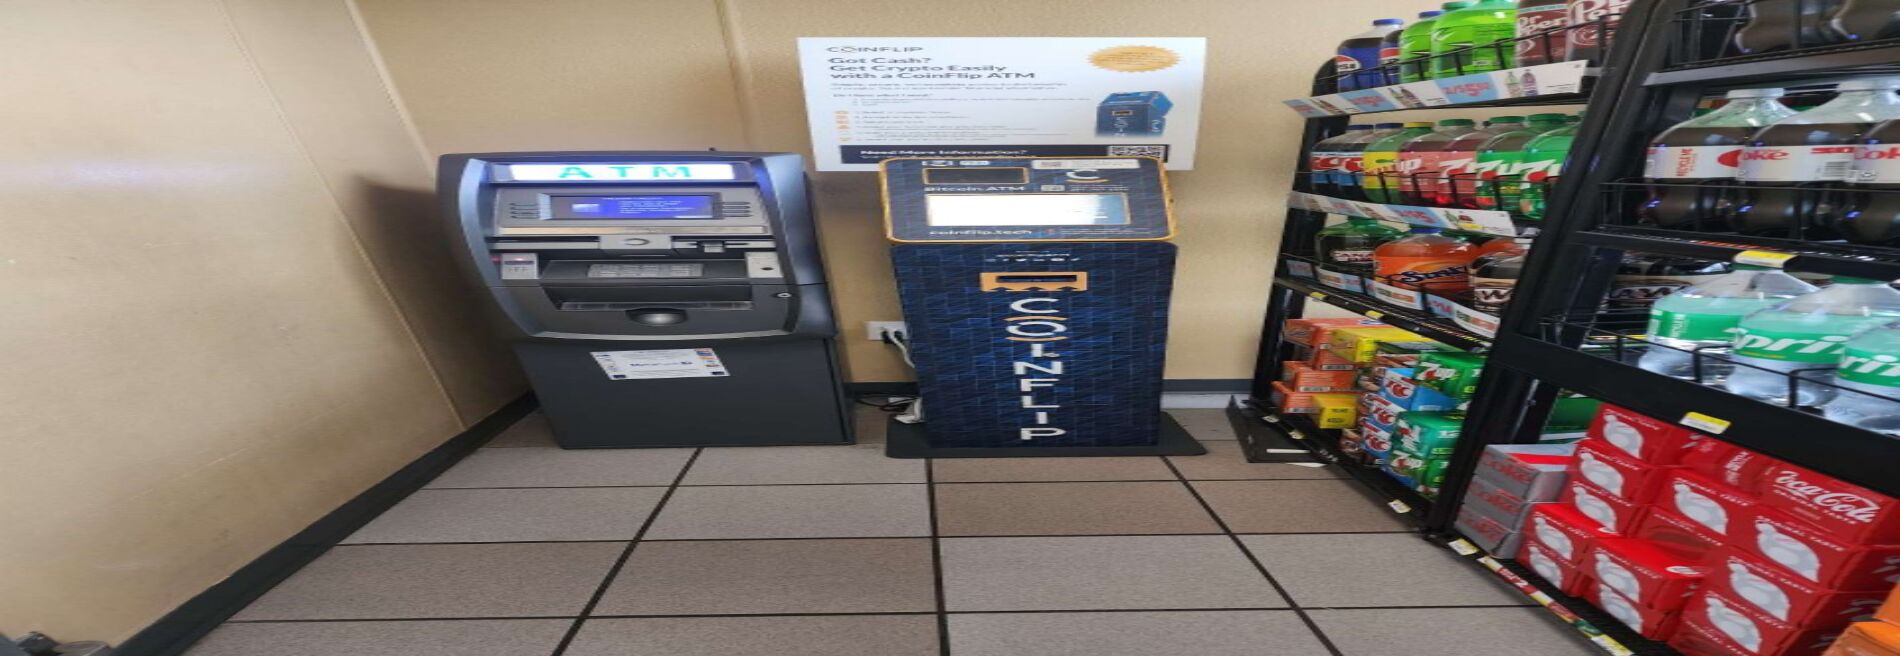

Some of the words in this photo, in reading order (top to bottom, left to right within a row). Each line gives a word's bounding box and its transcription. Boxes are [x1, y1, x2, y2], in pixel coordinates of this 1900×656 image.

[896, 72, 982, 80] CoinFlip
[558, 166, 692, 179] ATM
[1005, 298, 1068, 440] COINFLIP
